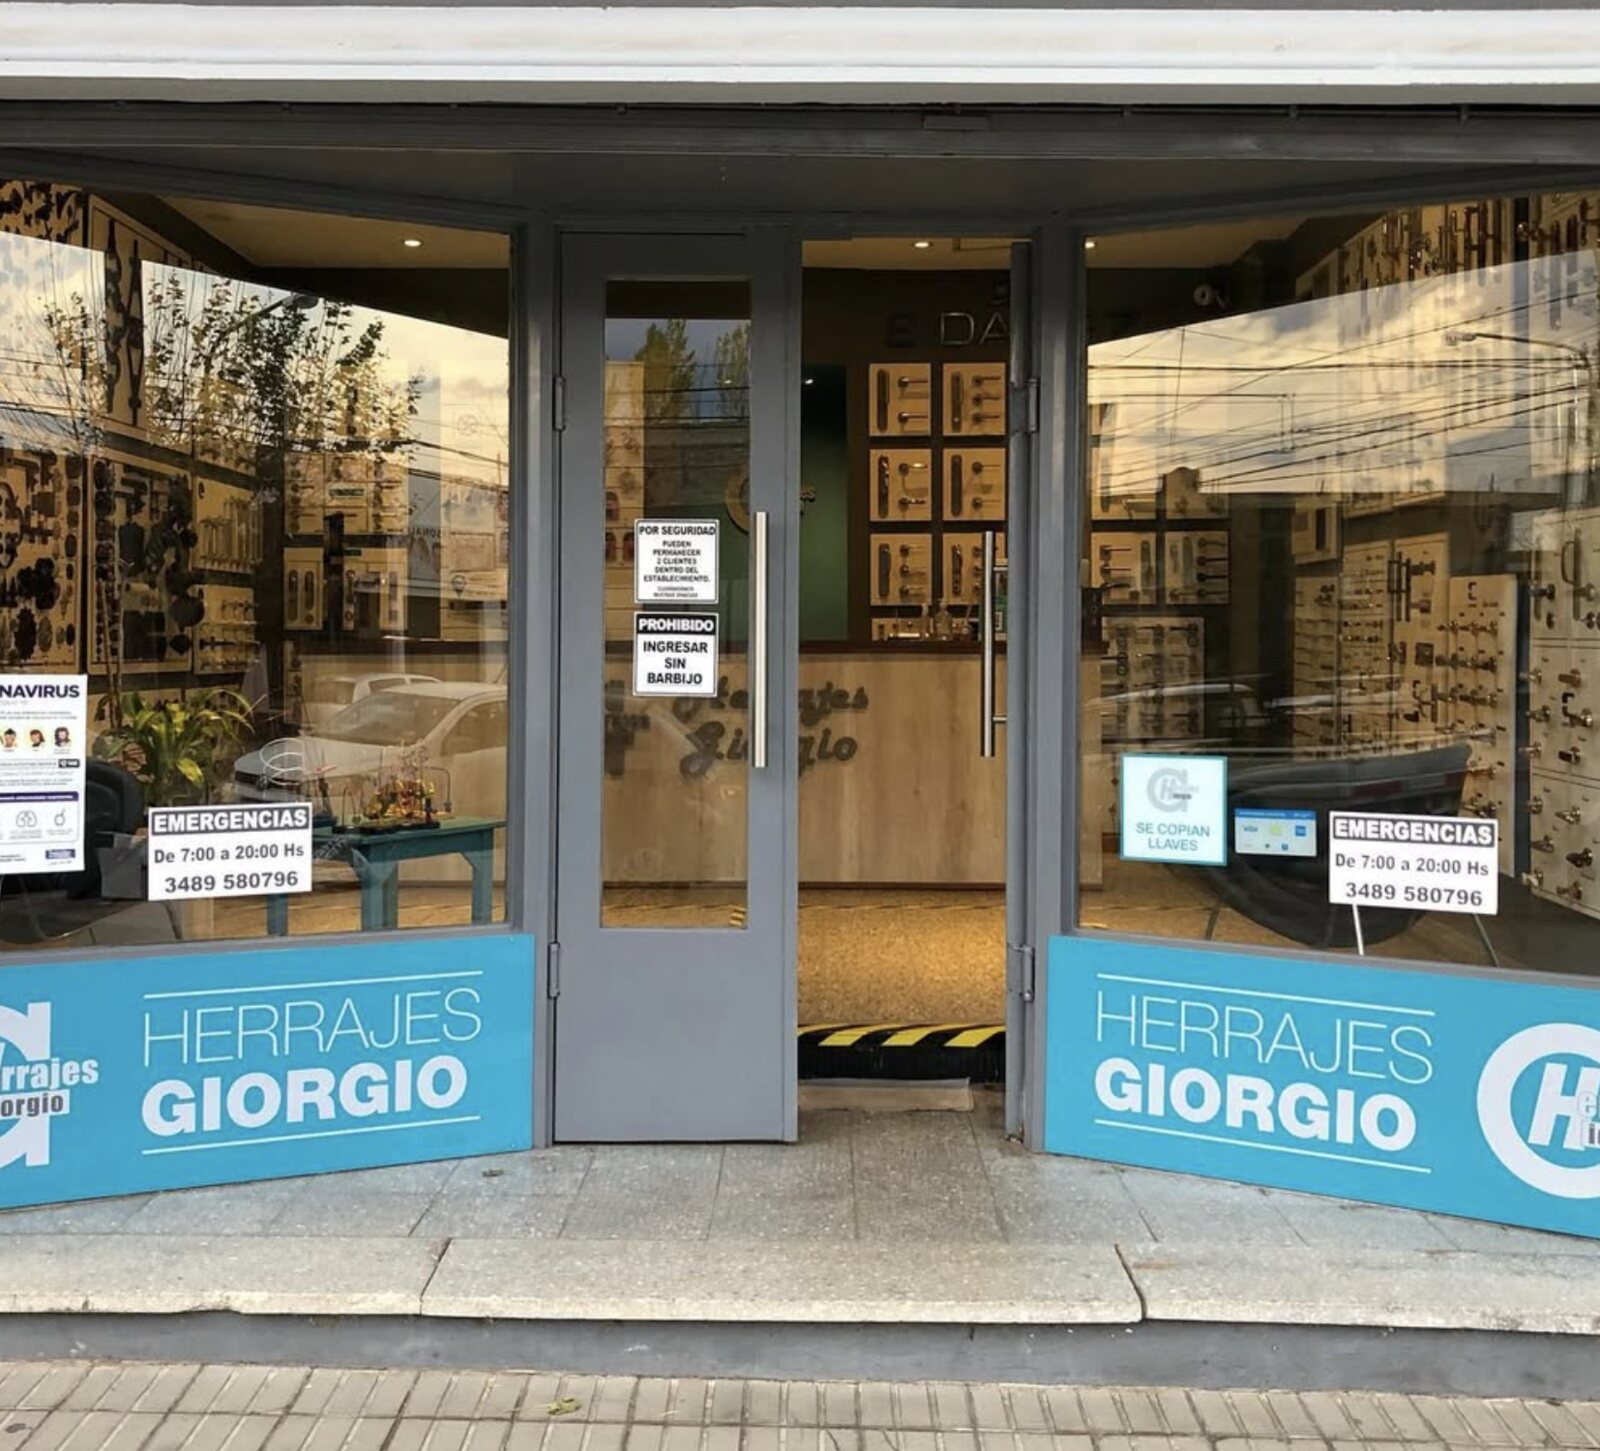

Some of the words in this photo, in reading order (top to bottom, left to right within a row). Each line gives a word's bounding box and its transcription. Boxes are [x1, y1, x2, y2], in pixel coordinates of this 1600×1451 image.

[639, 525, 660, 536] POR
[661, 525, 716, 536] SEGURIDAD
[662, 540, 692, 548] PUEDEN
[653, 549, 701, 557] PERMANECER
[656, 557, 662, 565] 2
[663, 557, 697, 565] CLIENTES
[655, 566, 684, 574] DENTRO
[686, 566, 699, 574] DEL
[638, 618, 714, 632] PROHIBIDO
[643, 641, 708, 653] INGRESAR
[664, 657, 687, 669] SIN
[647, 672, 703, 685] BARBIJO
[154, 809, 308, 833] EMERGENCIAS
[1136, 822, 1153, 834] SE
[1157, 823, 1211, 837] COPIAN
[1335, 819, 1493, 845] EMERGENCIAS
[1148, 837, 1198, 851] LLAVES
[154, 849, 175, 863] De
[181, 847, 215, 862] 7:00
[220, 850, 230, 860] a
[235, 844, 278, 859] 20:00
[284, 843, 304, 856] Hs
[1336, 853, 1356, 868] De
[1362, 854, 1396, 871] 7:00
[1401, 860, 1411, 871] a
[1416, 857, 1462, 874] 20:00
[1467, 860, 1489, 876] Hs
[165, 875, 216, 893] 3489
[223, 871, 298, 889] 580796
[1345, 882, 1396, 900] 3489
[1404, 885, 1482, 906] 580796
[144, 987, 482, 1067] HERRAJES
[1097, 990, 1434, 1085] HERRAJES
[141, 1054, 468, 1136] GIORGIO
[1094, 1057, 1417, 1152] GIORGIO
